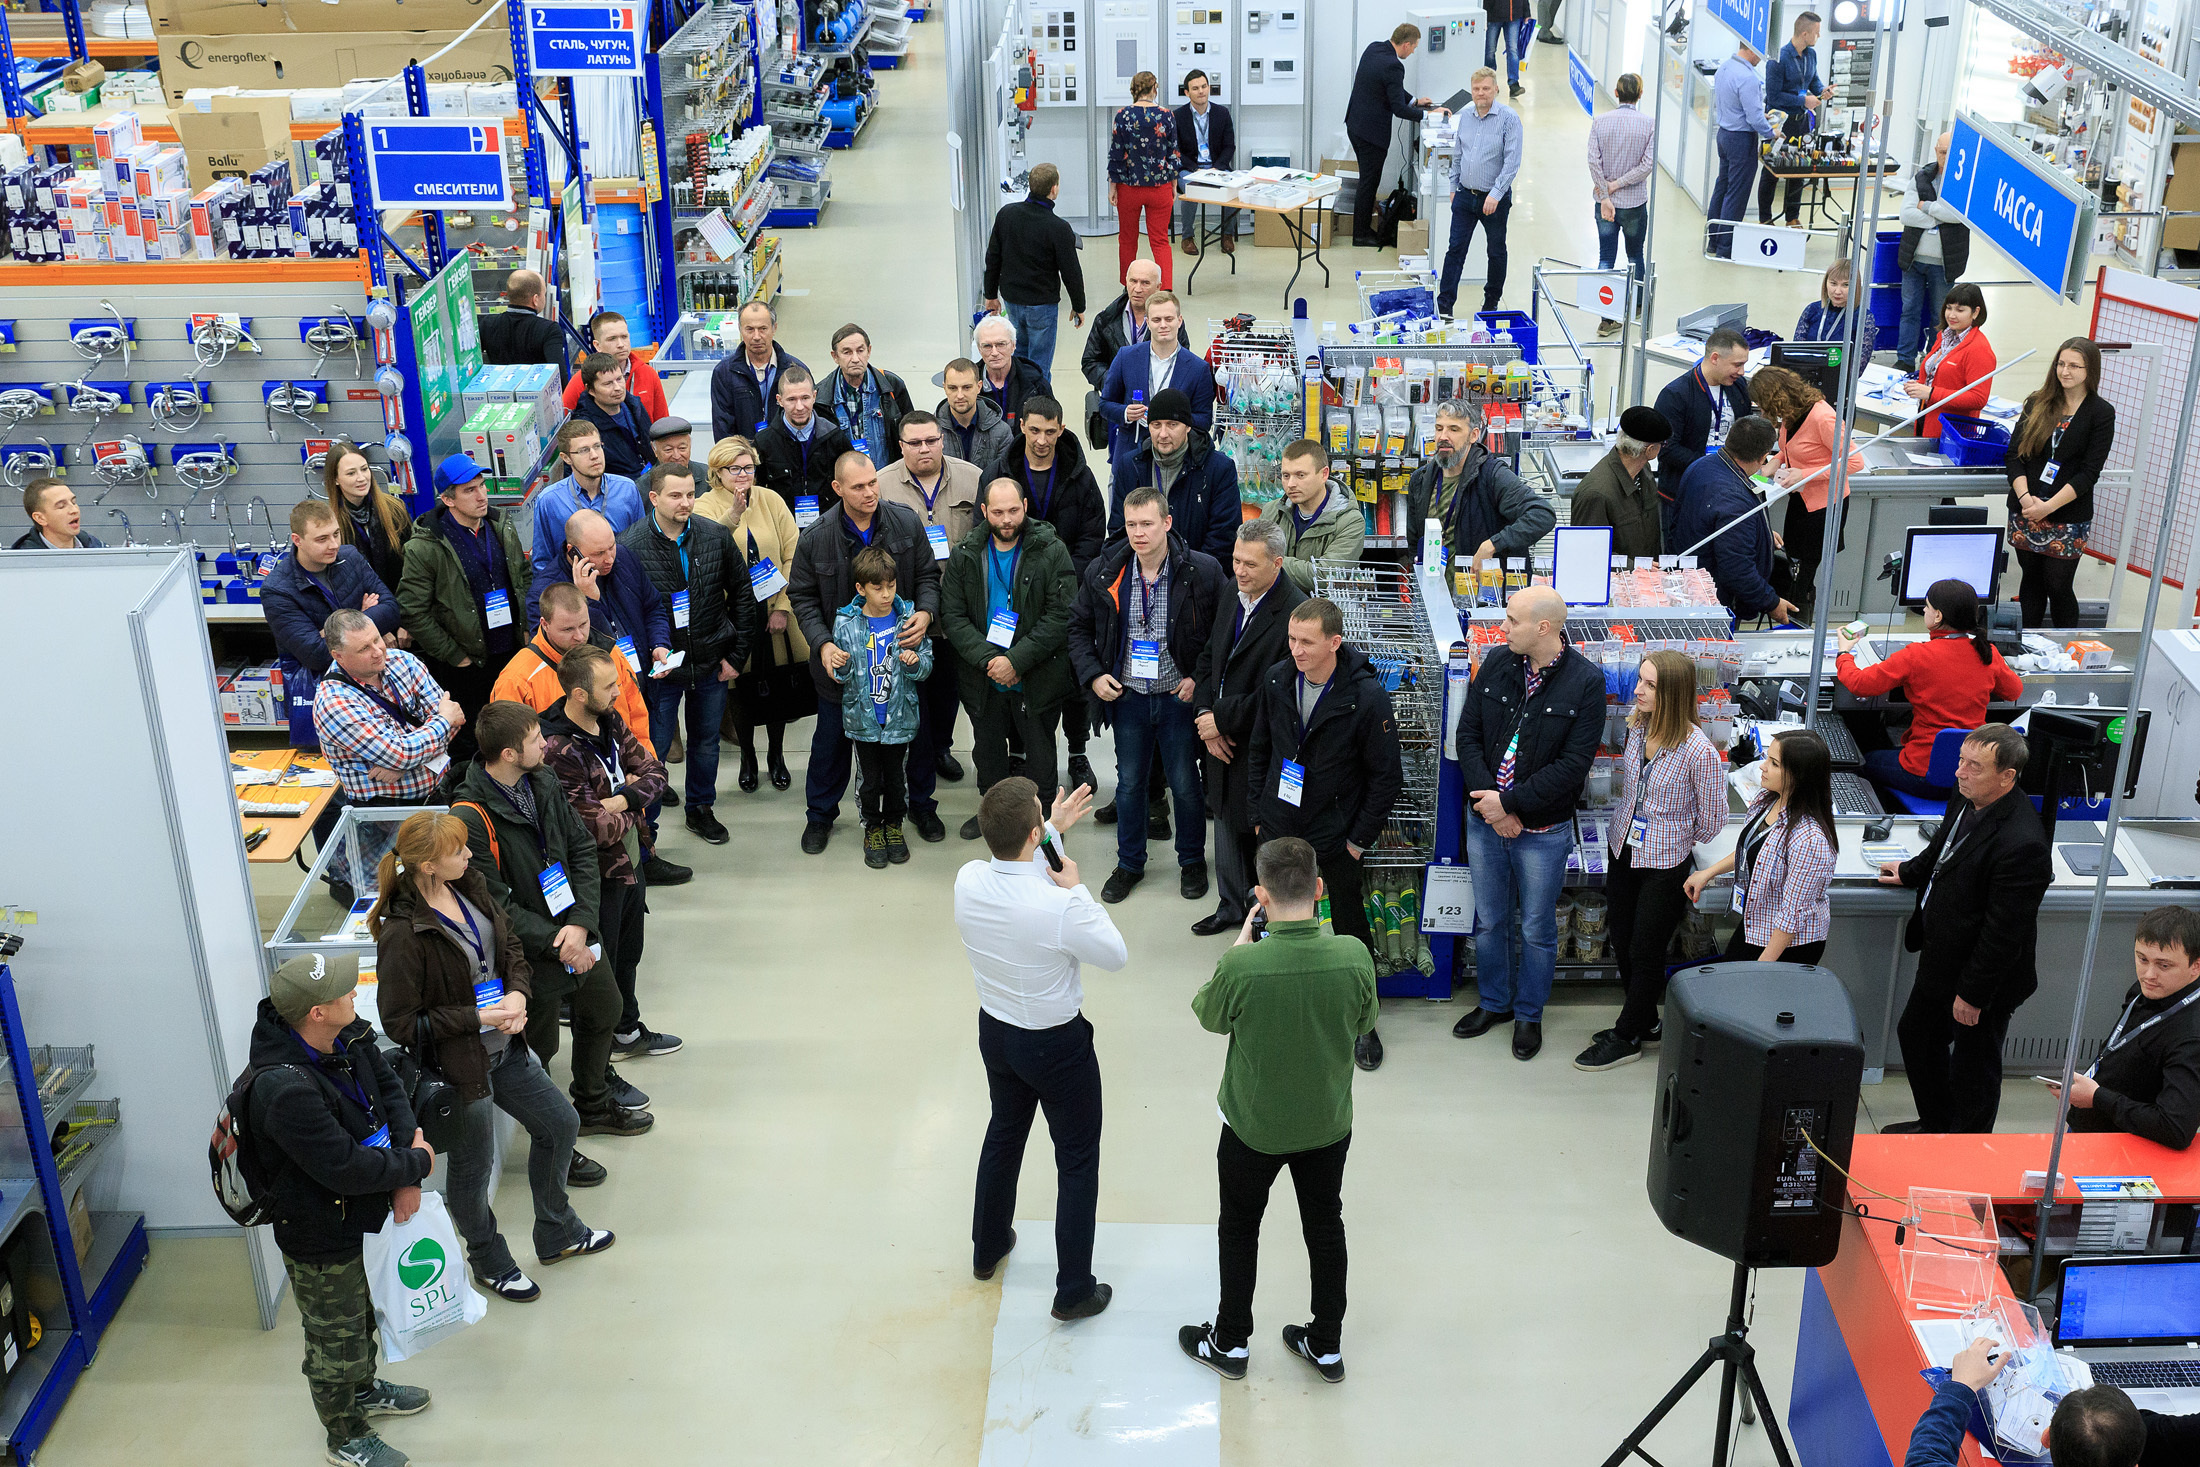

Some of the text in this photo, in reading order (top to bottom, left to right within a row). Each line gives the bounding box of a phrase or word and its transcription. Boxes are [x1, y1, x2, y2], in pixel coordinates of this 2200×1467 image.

[536, 10, 547, 26] 2
[1758, 7, 1764, 32] 2
[549, 39, 630, 51] СТАЛЬ, ЧУГУН,
[207, 51, 267, 65] energoflex
[586, 54, 632, 65] ЛАТУНЬ
[428, 70, 487, 82] energoflex
[378, 128, 389, 149] 1
[208, 154, 238, 166] Ballu
[1954, 148, 1966, 181] 3
[414, 183, 499, 195] СМЕСИТЕЛИ
[1993, 178, 2044, 247] КАССА
[414, 293, 437, 325] ГЕЙЗЕР
[1437, 905, 1462, 916] 123
[410, 1284, 456, 1318] SPL
